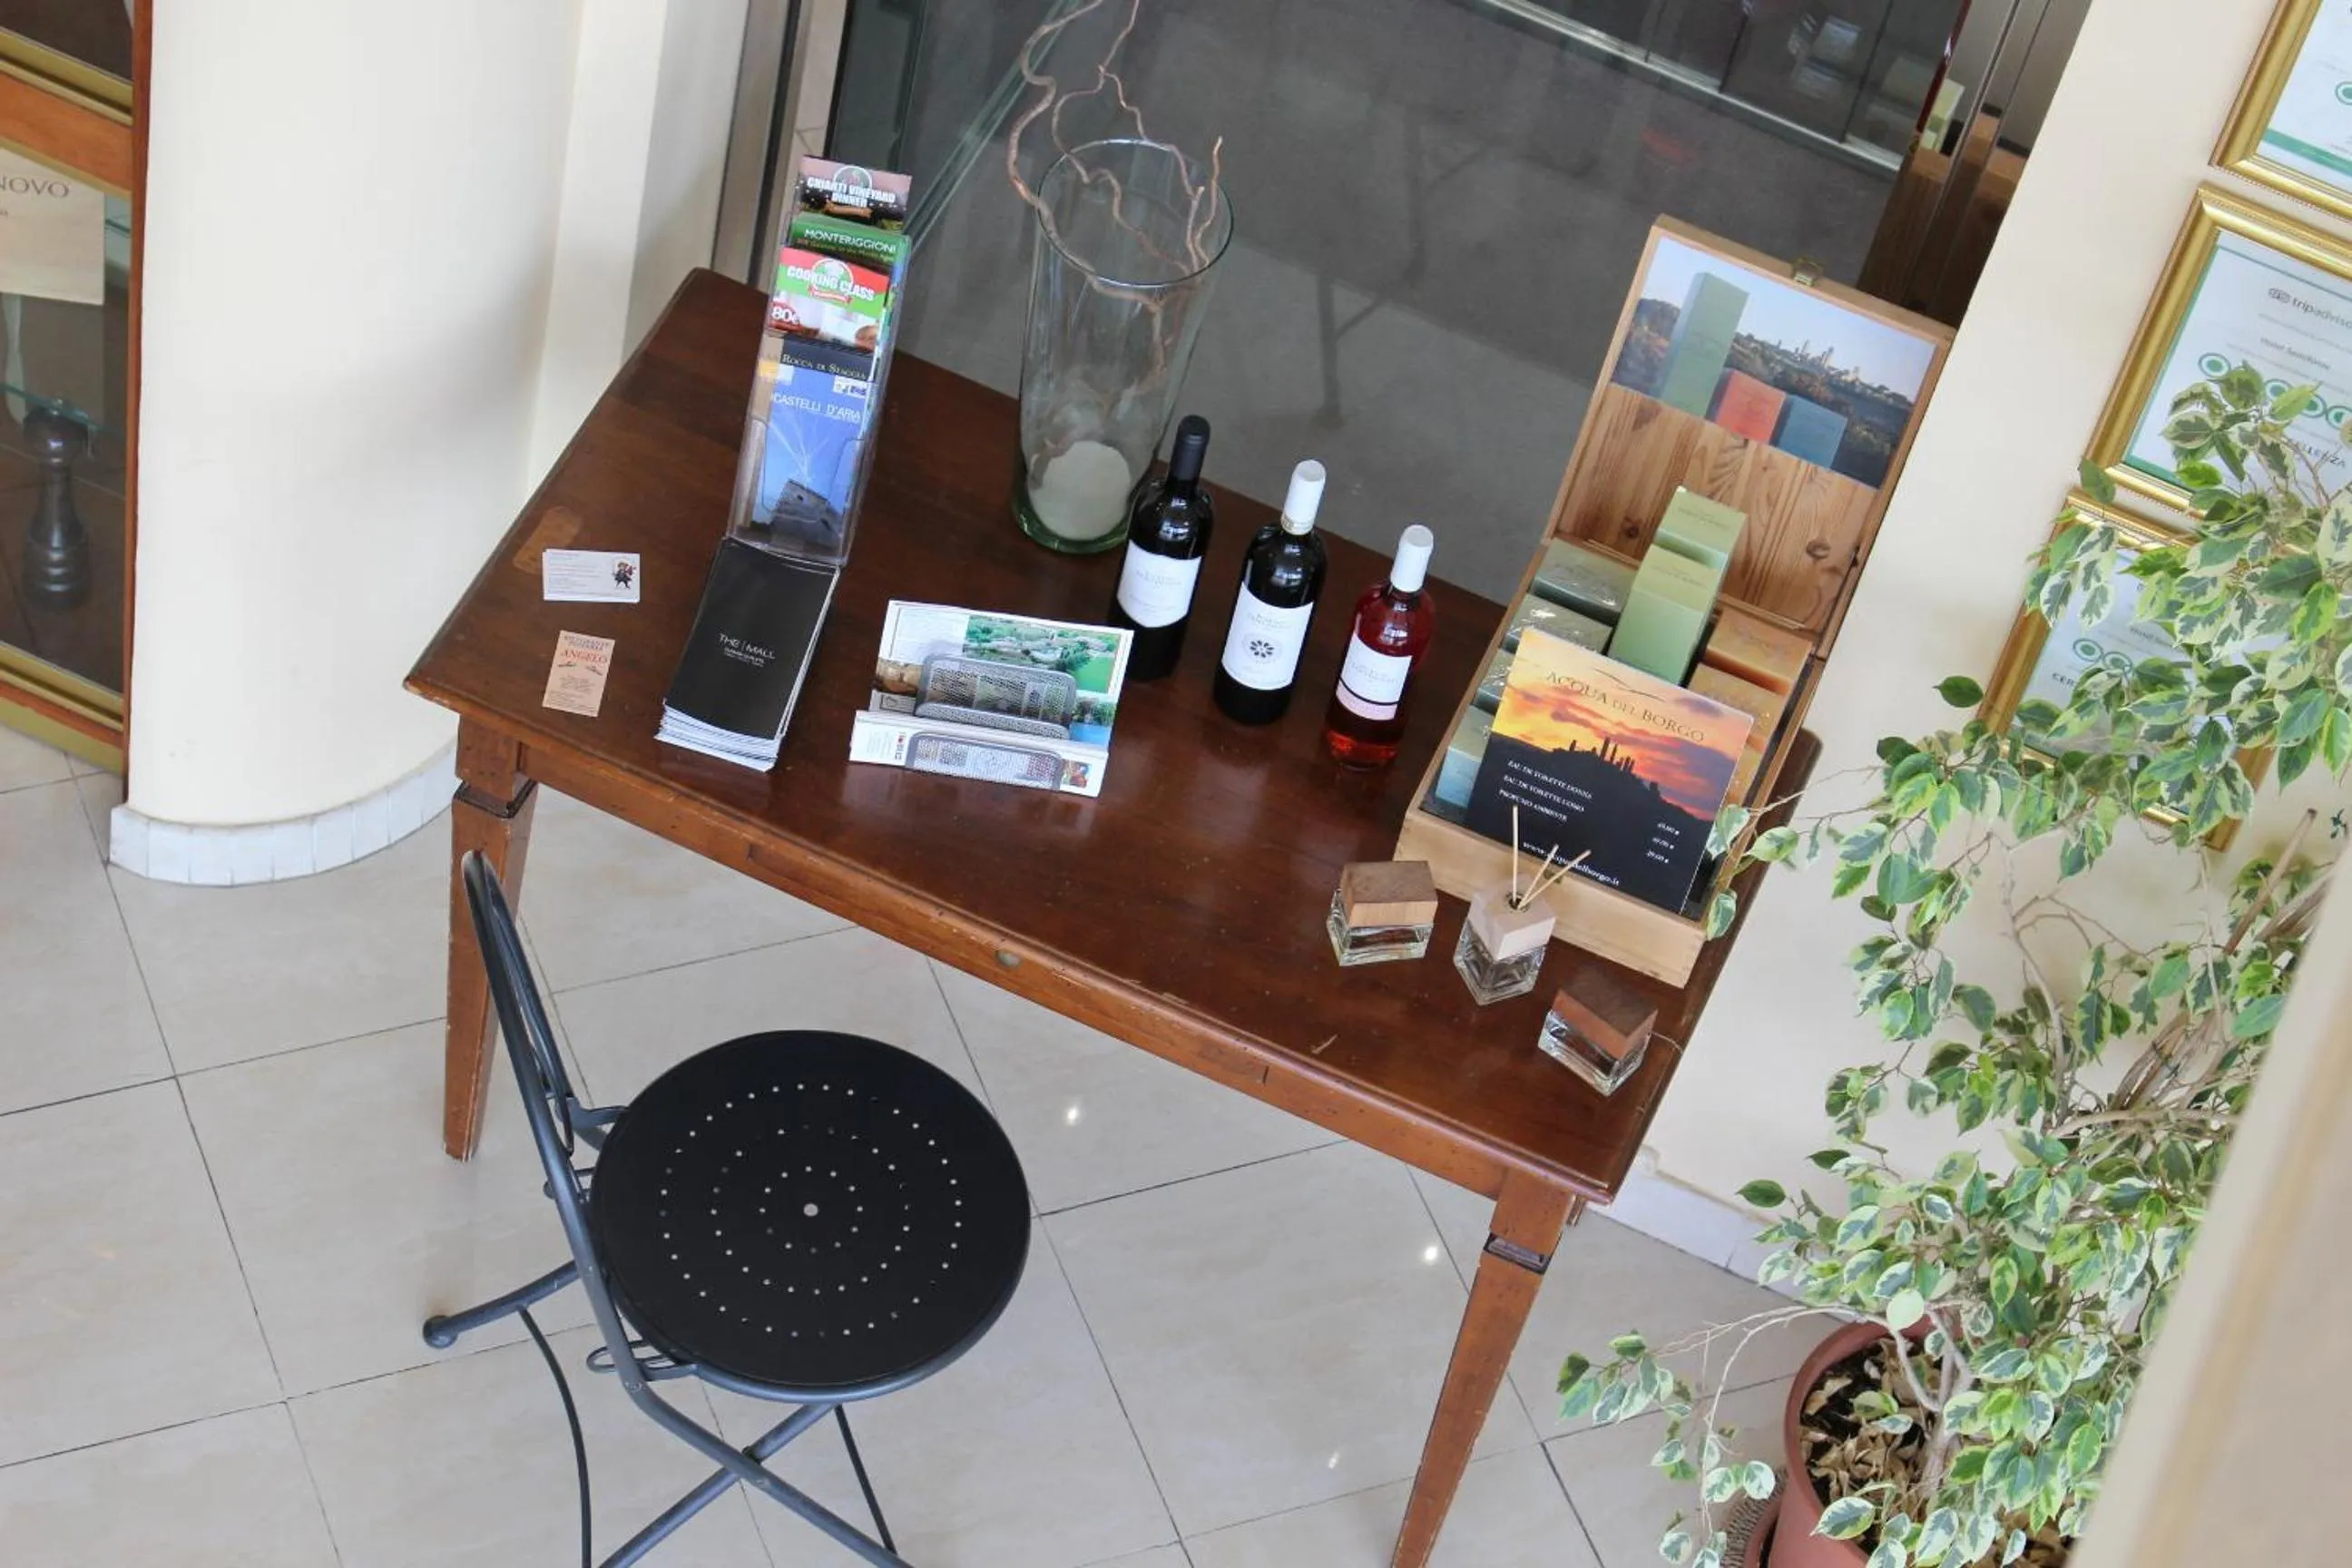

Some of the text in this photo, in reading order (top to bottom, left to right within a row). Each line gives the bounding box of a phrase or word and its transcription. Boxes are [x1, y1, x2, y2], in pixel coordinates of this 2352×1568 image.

[807, 176, 896, 203] CHIANTI VINEYARD
[831, 191, 867, 208] DINNER
[804, 228, 897, 254] MONTERIGGIONI
[787, 264, 875, 302] COOKING CLASS
[774, 392, 821, 413] CASTELLI
[1547, 671, 1704, 743] ACQUA DEL BORGO
